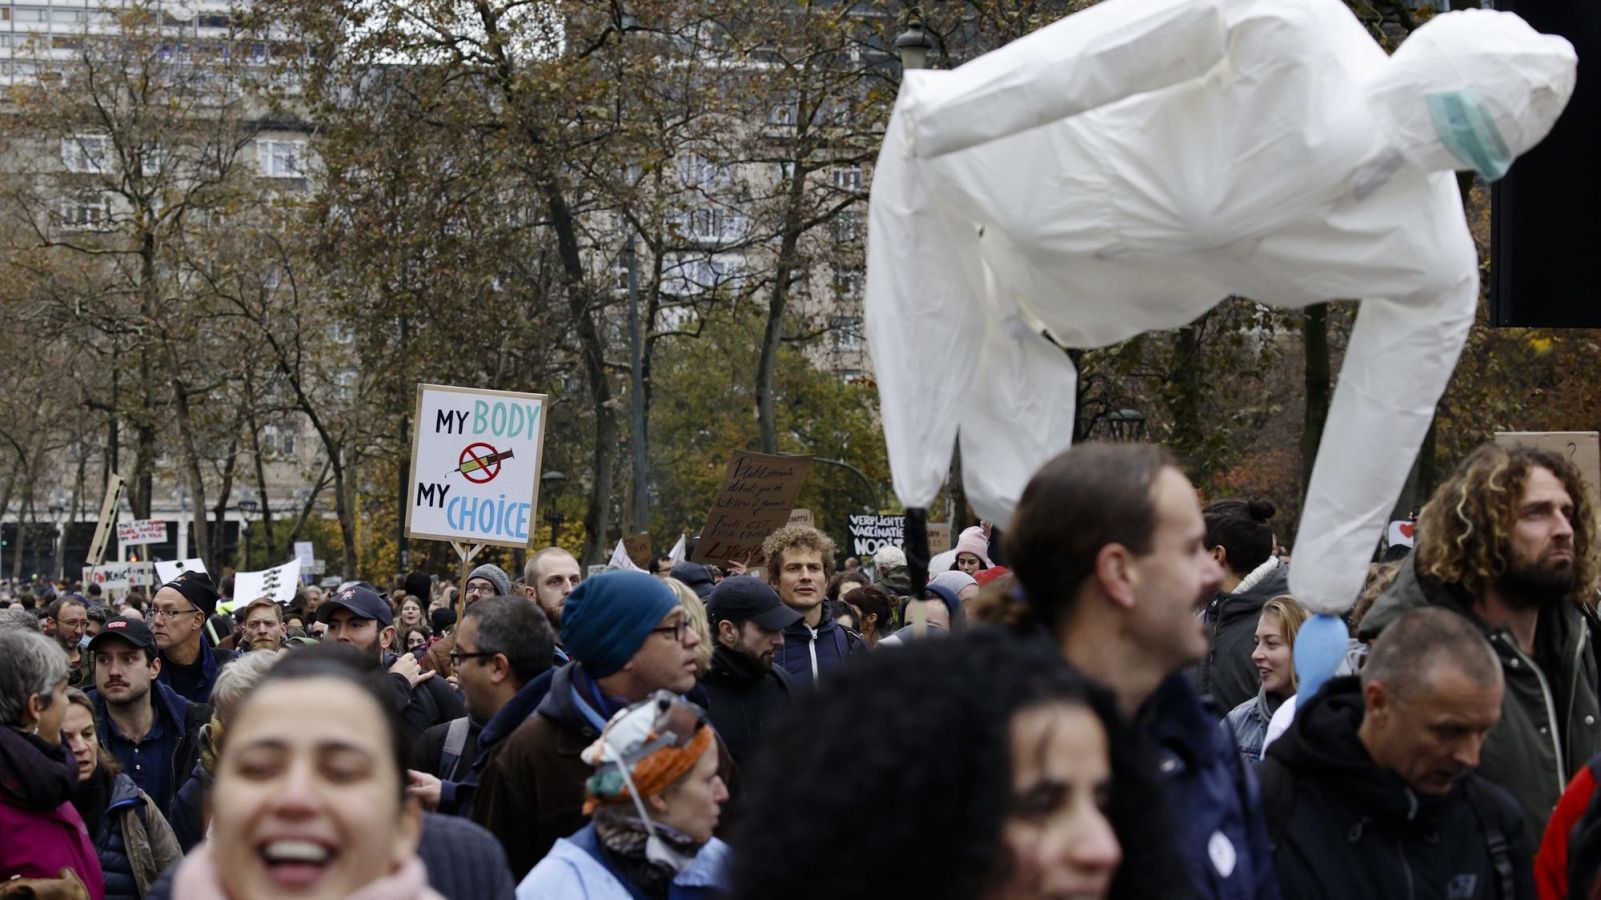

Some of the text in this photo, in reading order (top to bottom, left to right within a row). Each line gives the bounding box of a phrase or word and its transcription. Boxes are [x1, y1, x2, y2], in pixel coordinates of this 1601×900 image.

[436, 400, 540, 440] MY BODY
[416, 482, 531, 539] MY CHOICE
[849, 514, 906, 527] VERPLICHTE
[848, 525, 904, 538] VACCINATIE
